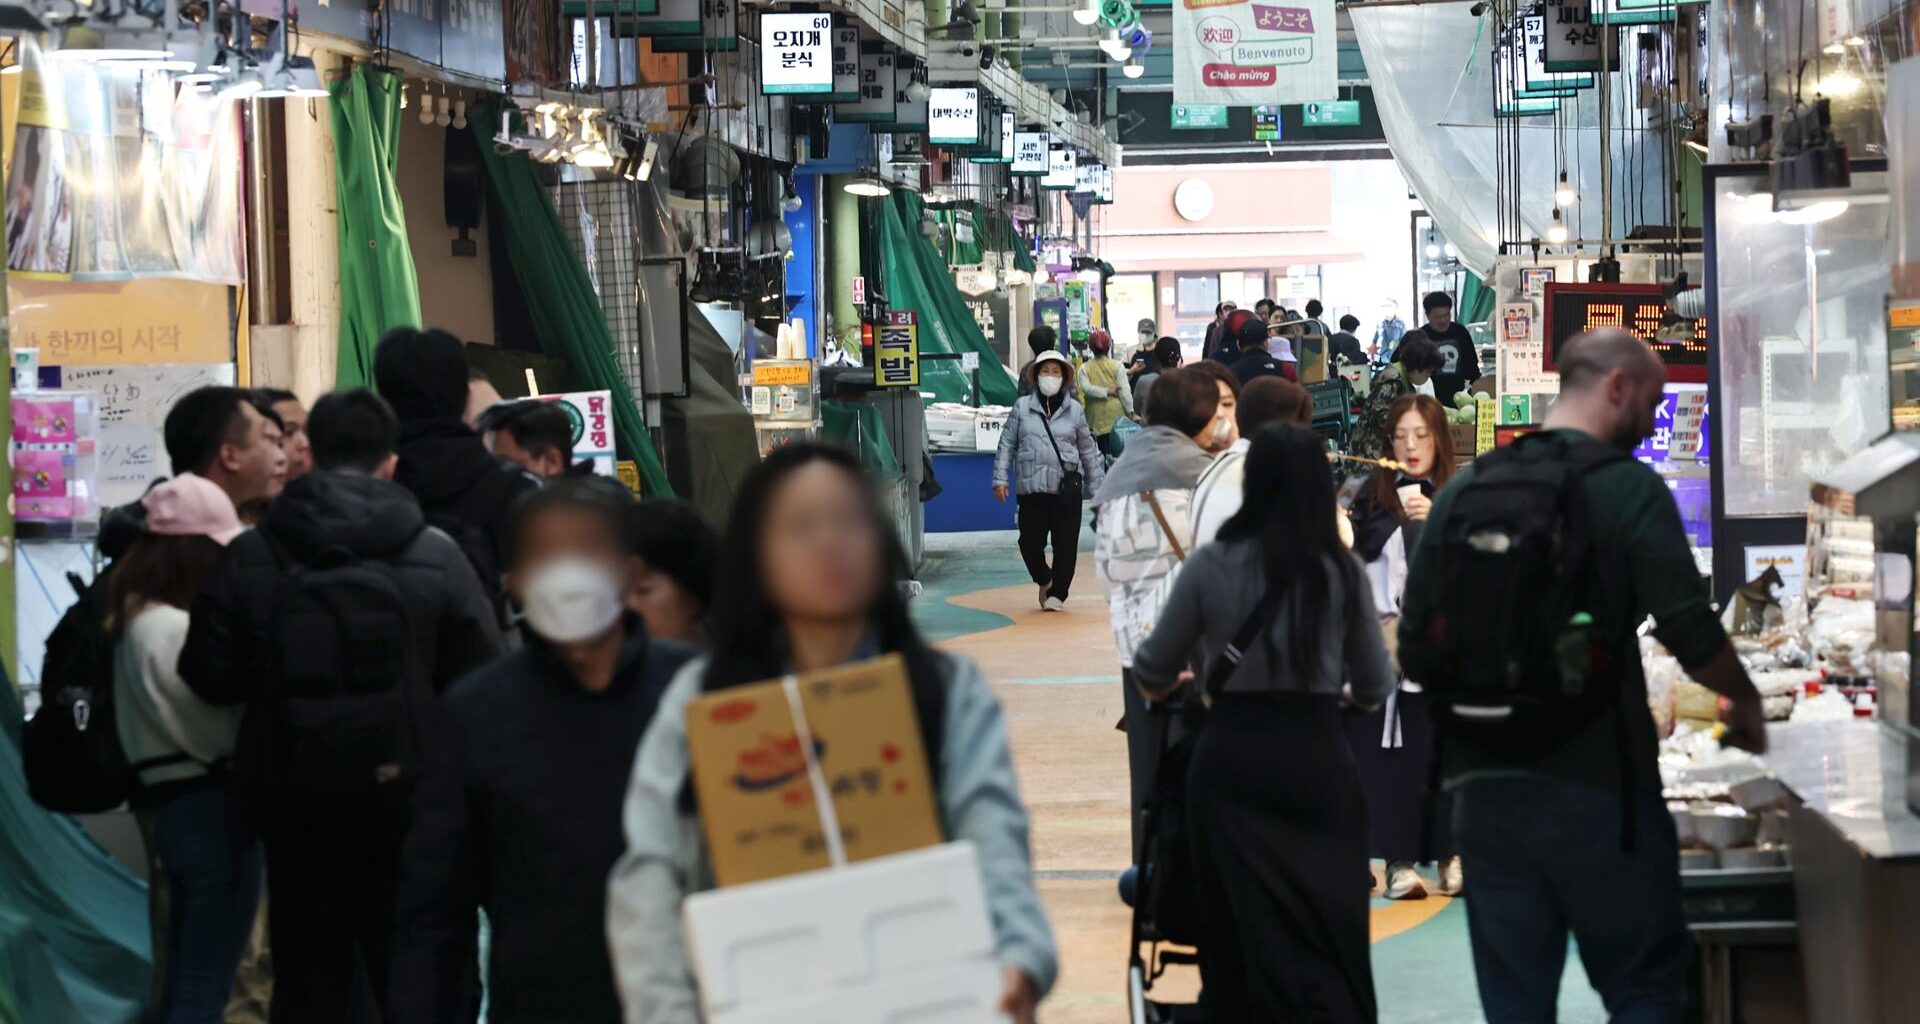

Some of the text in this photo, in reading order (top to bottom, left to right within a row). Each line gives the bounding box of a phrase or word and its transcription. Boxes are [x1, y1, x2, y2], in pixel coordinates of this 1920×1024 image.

[813, 17, 829, 29] 60
[1259, 11, 1308, 29] ようこそ
[1526, 20, 1541, 31] 57
[773, 30, 821, 47] 오지개
[841, 31, 856, 42] 62
[1203, 27, 1233, 43] 欢迎
[1565, 27, 1598, 45] 수산
[781, 52, 813, 69] 분식
[878, 56, 892, 67] 64
[1238, 47, 1305, 60] Benvenuto
[965, 91, 976, 100] 70
[932, 108, 973, 118] 대박수산
[47, 328, 123, 357] 한끼의
[131, 324, 182, 350] 시작
[880, 328, 915, 382] 족발
[587, 396, 608, 448] 닭강정
